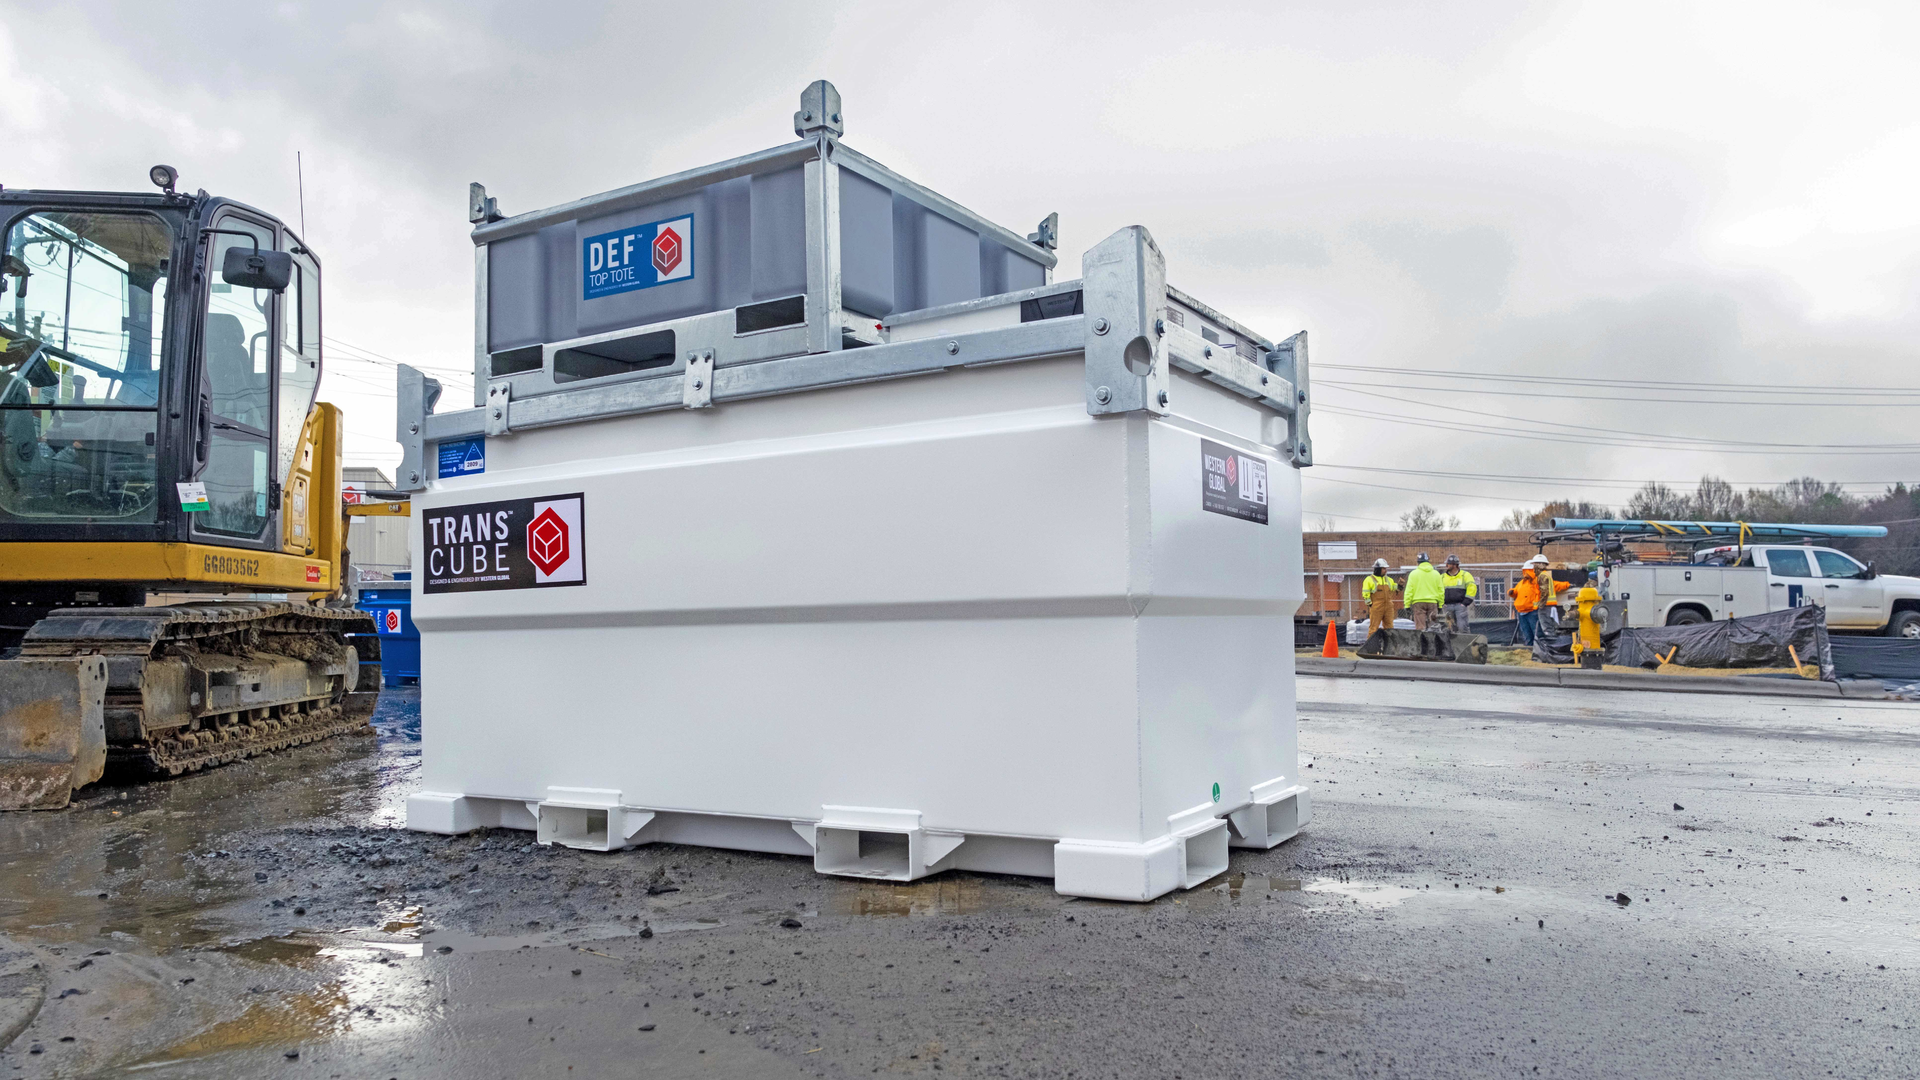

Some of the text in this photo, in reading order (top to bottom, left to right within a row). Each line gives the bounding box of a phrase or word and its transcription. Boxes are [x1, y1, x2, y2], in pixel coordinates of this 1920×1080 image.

[589, 272, 609, 287] TOP
[609, 266, 635, 283] TOTE
[1204, 453, 1226, 475] WESTERN
[1208, 472, 1227, 493] GLOBAL
[388, 504, 400, 512] CAT
[204, 554, 259, 577] GG803562
[430, 542, 510, 576] CUBE
[451, 576, 475, 584] ENGINEERED
